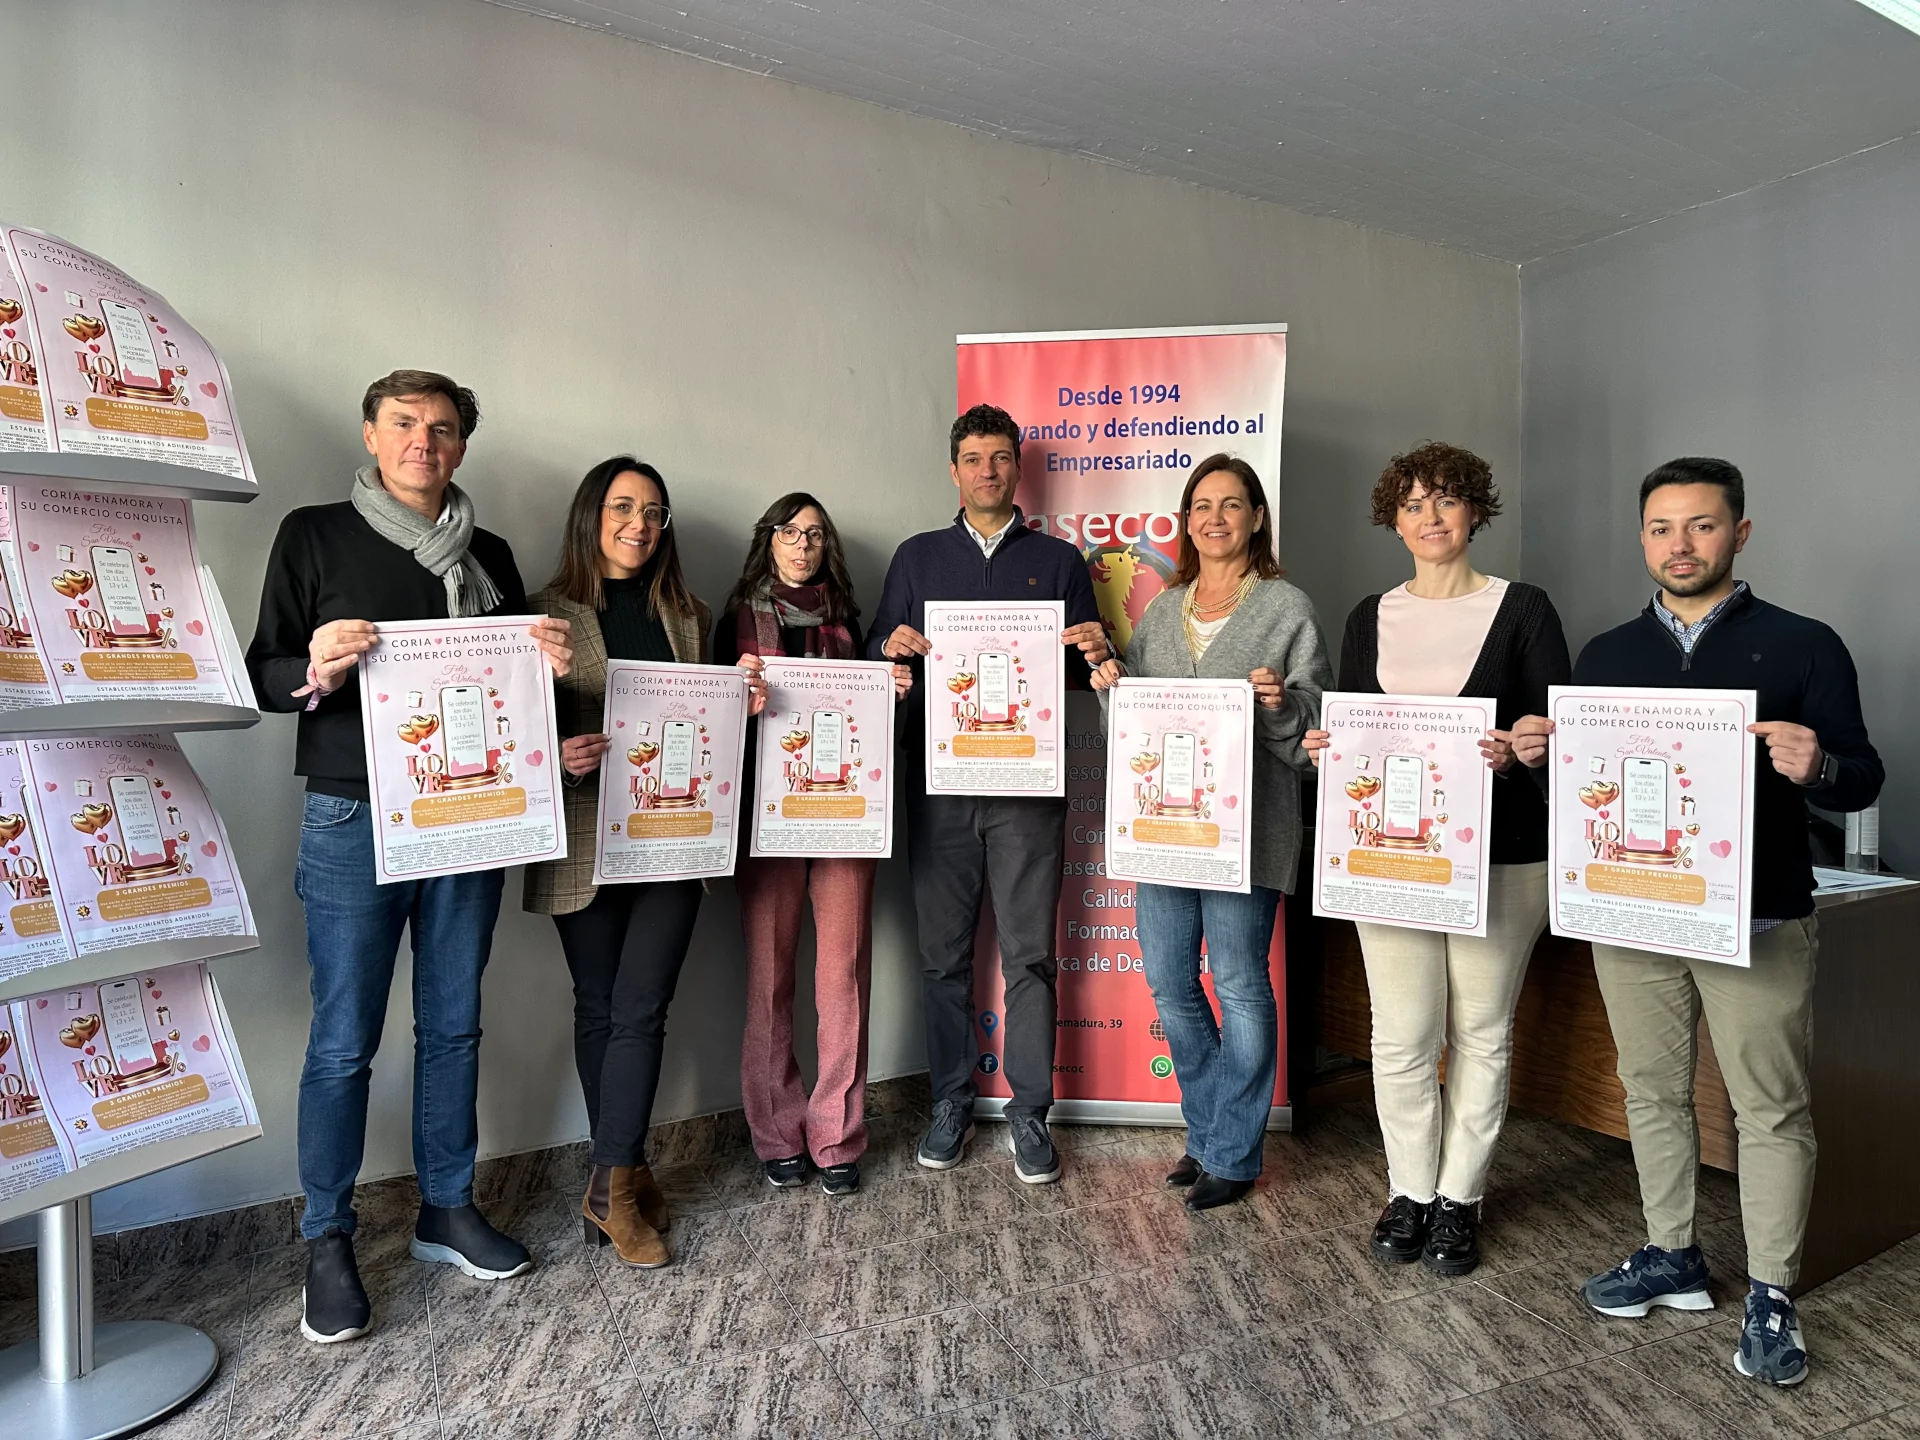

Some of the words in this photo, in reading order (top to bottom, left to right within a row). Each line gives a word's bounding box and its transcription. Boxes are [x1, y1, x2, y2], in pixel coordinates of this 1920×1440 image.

[38, 243, 78, 260] CORIA
[21, 249, 37, 258] SU
[44, 256, 110, 280] COMERCIO
[1058, 385, 1123, 407] Desde
[1129, 384, 1180, 404] 1994
[112, 403, 149, 413] GRANDES
[1019, 419, 1081, 444] yando
[1087, 422, 1098, 444] y
[1104, 414, 1240, 438] defendiendo
[1245, 413, 1264, 434] al
[98, 435, 165, 447] ESTABLECIMIENTOS
[1047, 449, 1192, 476] Empresariado
[41, 489, 81, 501] CORIA
[94, 494, 153, 509] ENAMORA
[157, 501, 164, 510] Y
[21, 501, 37, 511] SU
[43, 503, 110, 518] COMERCIO
[116, 511, 183, 525] CONQUISTA
[1029, 513, 1178, 544] aseco
[392, 637, 432, 648] CORIA
[446, 633, 507, 645] ENAMORA
[371, 654, 388, 663] SU
[394, 649, 461, 662] COMERCIO
[467, 644, 537, 657] CONQUISTA
[633, 676, 664, 685] CORIA
[674, 678, 721, 687] ENAMORA
[784, 682, 832, 690] COMERCIO
[835, 683, 886, 692] CONQUISTA
[633, 688, 685, 698] COMERCIO
[689, 690, 741, 699] CONQUISTA
[1349, 709, 1384, 718] CORIA
[1396, 711, 1452, 720] ENAMORA
[1580, 704, 1619, 714] CORIA
[1634, 706, 1702, 716] ENAMORA
[1708, 708, 1716, 716] Y
[1331, 720, 1345, 728] SU
[1350, 721, 1409, 731] COMERCIO
[1414, 724, 1481, 734] CONQUISTA
[1560, 716, 1576, 726] SU
[1581, 718, 1650, 729] COMERCIO
[1656, 719, 1738, 732] CONQUISTA
[33, 742, 50, 752] SU
[57, 739, 123, 750] COMERCIO
[127, 740, 179, 753] CONQUISTA
[437, 794, 471, 803] GRANDES
[420, 827, 483, 839] ESTABLECIMIENTOS
[1610, 867, 1645, 876] GRANDES
[122, 885, 157, 895] GRANDES
[1352, 880, 1408, 891] ESTABLECIMIENTOS
[1082, 888, 1136, 908] Calid
[1592, 898, 1655, 911] ESTABLECIMIENTOS
[111, 920, 173, 933] ESTABLECIMIENTOS
[1067, 920, 1138, 940] Formac
[1087, 952, 1111, 972] de
[1110, 1019, 1122, 1028] 39
[117, 1090, 151, 1104] GRANDES
[112, 1118, 174, 1142] ESTABLECIMIENTOS
